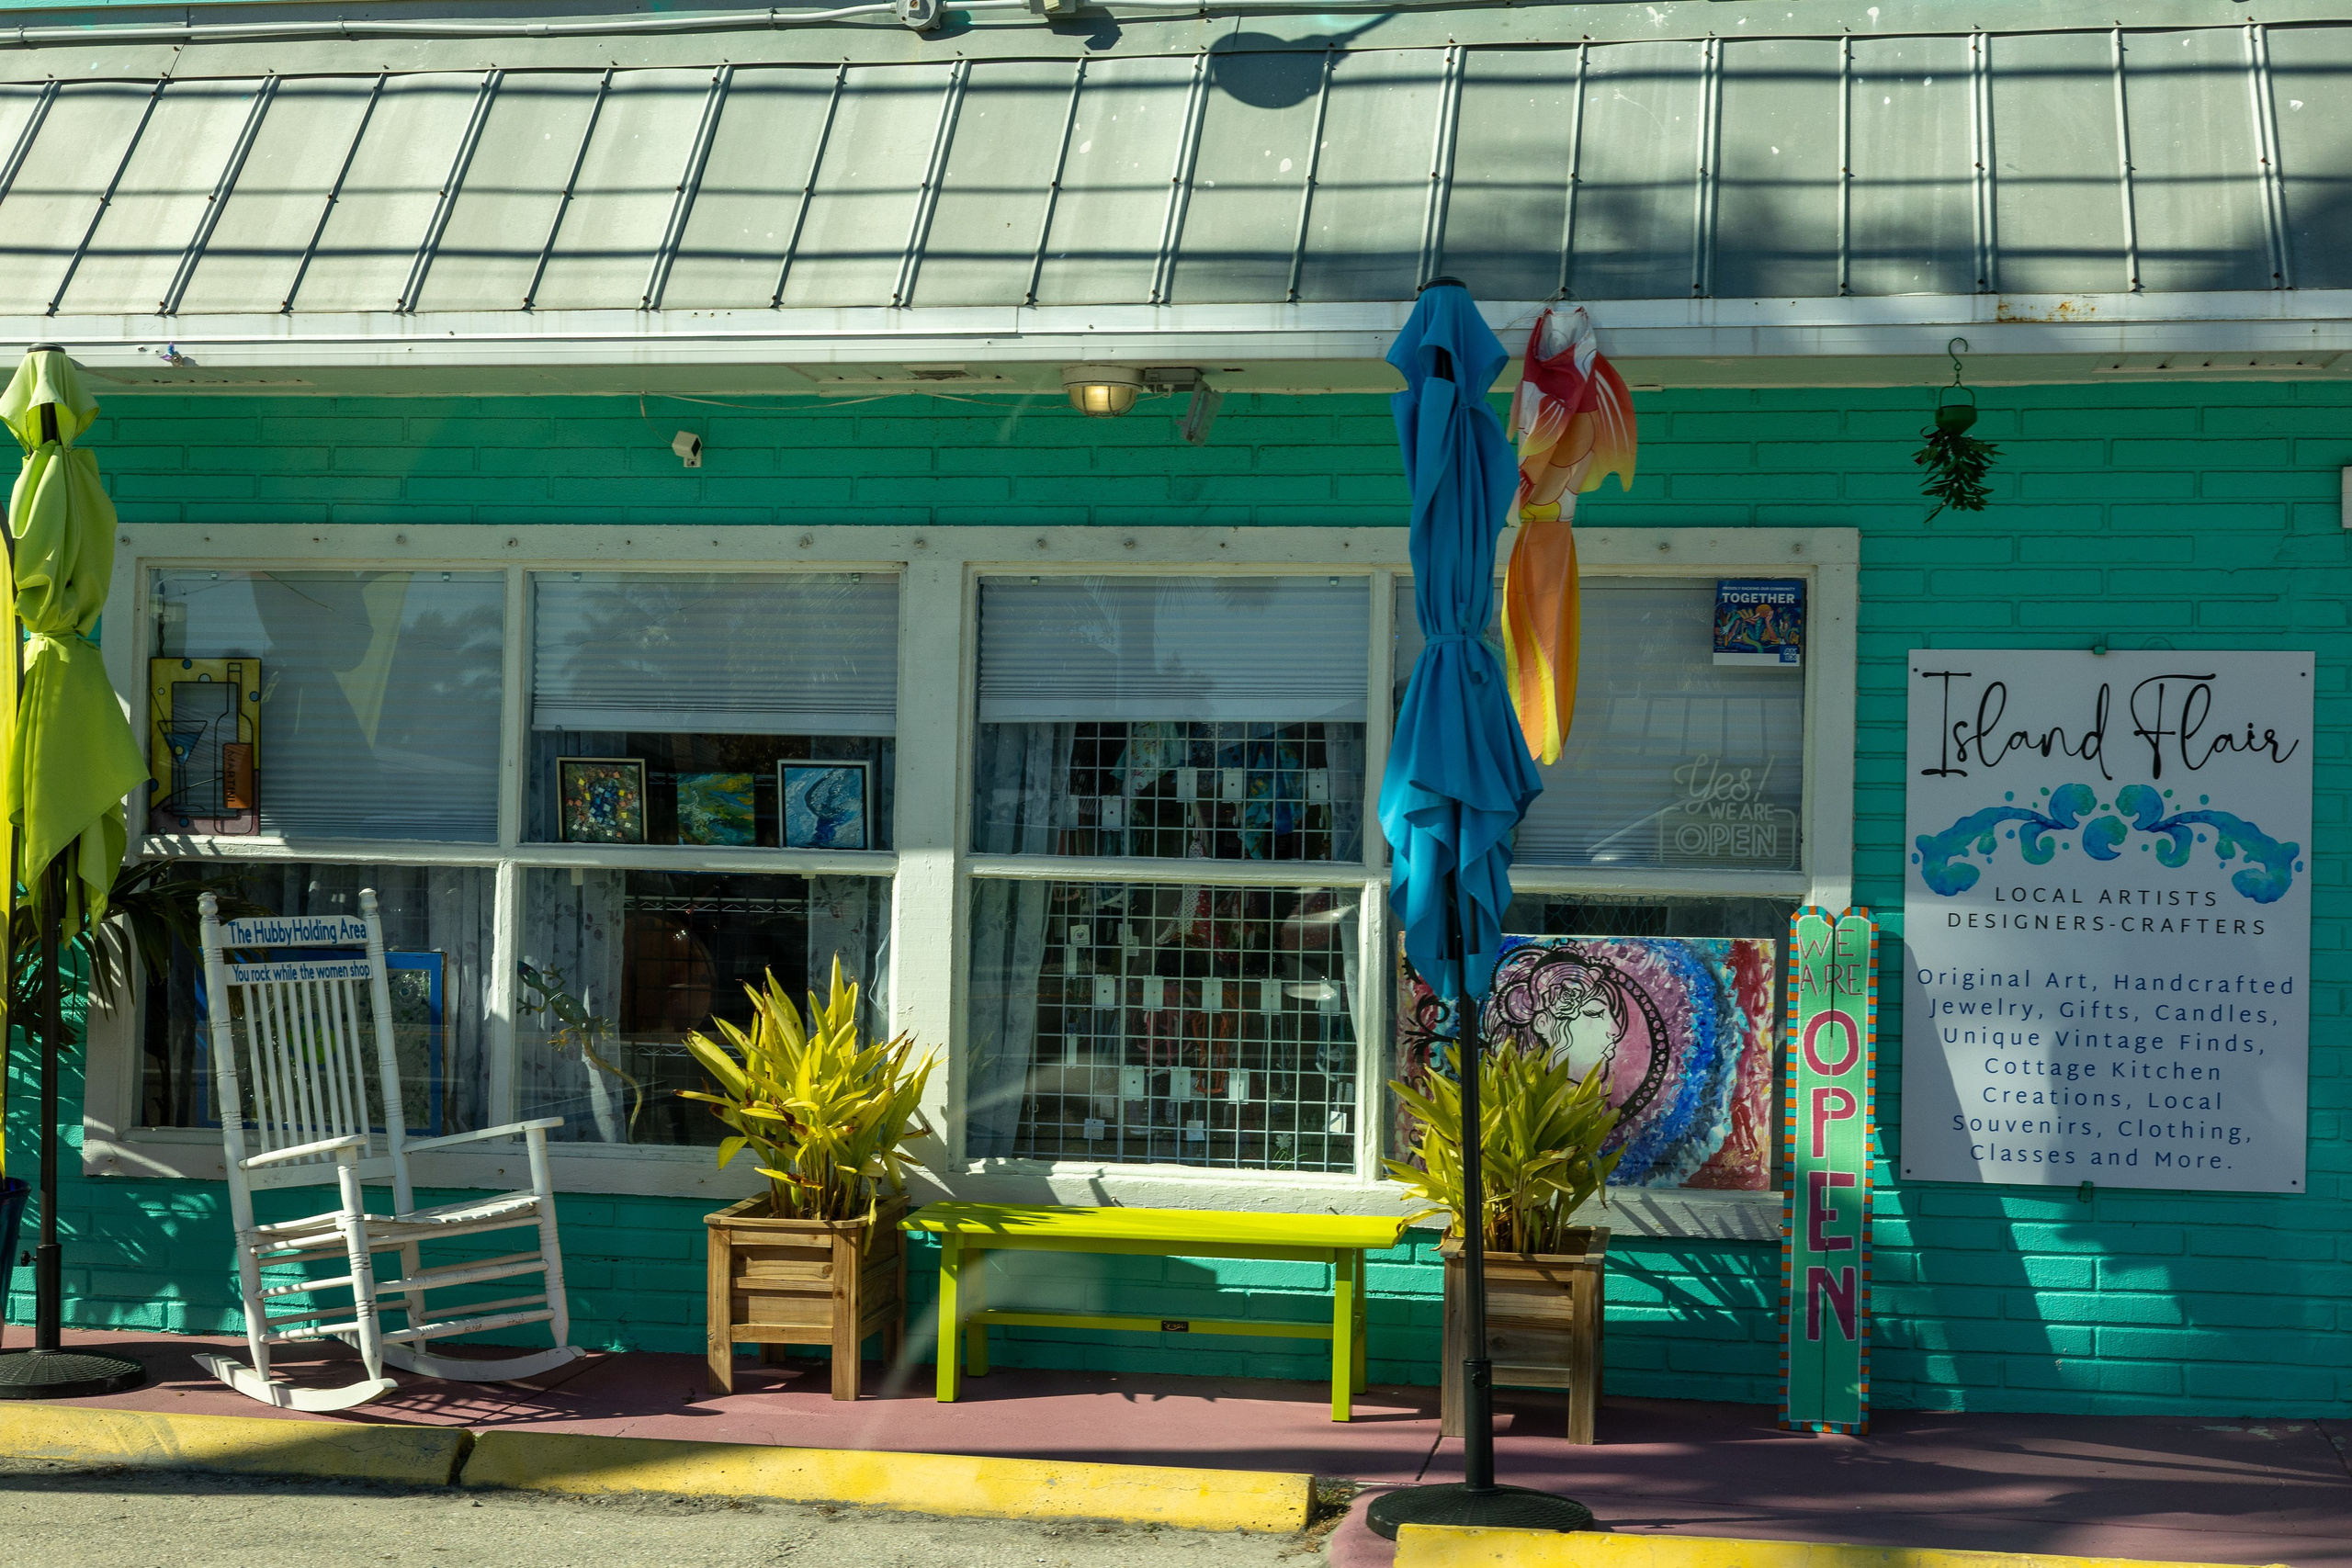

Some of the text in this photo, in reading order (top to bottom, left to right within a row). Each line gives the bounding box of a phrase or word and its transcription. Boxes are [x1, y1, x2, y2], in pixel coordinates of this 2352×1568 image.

[1721, 592, 1795, 604] TOGETHER
[1921, 671, 2300, 781] Island Flair
[227, 750, 235, 802] MARTINI
[1674, 753, 1775, 815] Yes!
[1707, 802, 1775, 821] WE ARE
[1675, 823, 1777, 858] OPEN
[1995, 886, 2217, 907] LOCAL ARTISTS
[228, 921, 252, 944] The
[340, 918, 367, 940] Area
[1948, 912, 2266, 935] DESIGNERS-CRAFTERS
[1799, 929, 1855, 961] WE
[232, 961, 370, 982] You rock while the women shop
[1800, 964, 1863, 997] ARE
[1917, 968, 2294, 995] Original Art, Handcrafted
[1928, 998, 2278, 1027] Jewelry, Gifts, Candles,
[1943, 1027, 2266, 1056] Unique Vintage Finds,
[1984, 1057, 2221, 1081] Cottage Kitchen
[1983, 1087, 2222, 1111] Creations, Local
[1952, 1115, 2252, 1145] Souvenirs, Clothing,
[1970, 1144, 2233, 1170] Classes and More.
[1803, 1009, 1860, 1341] OPEN
